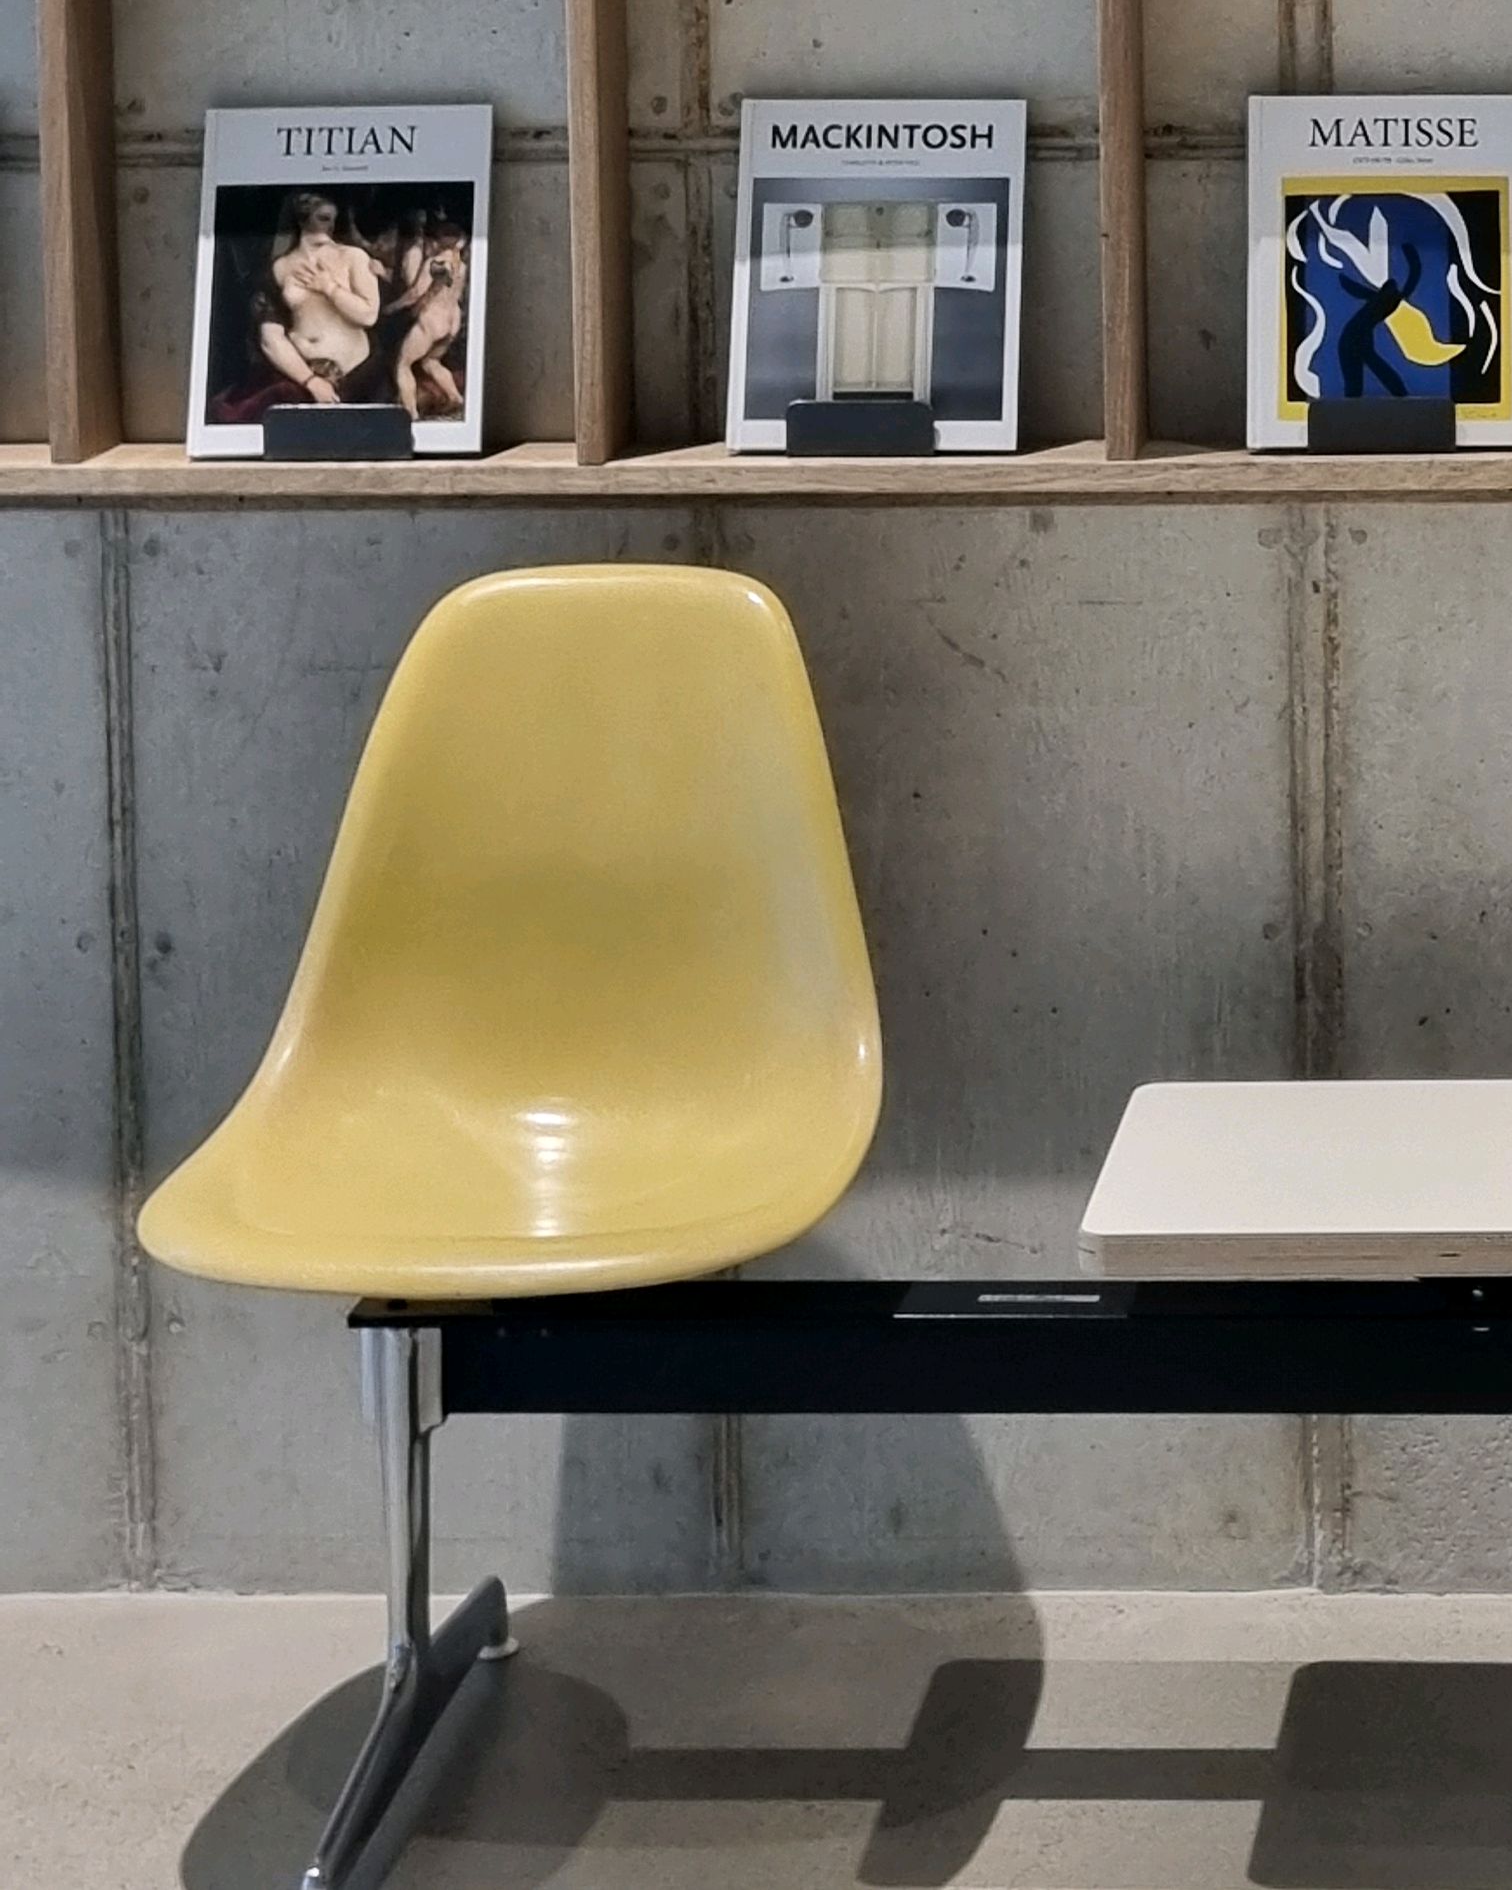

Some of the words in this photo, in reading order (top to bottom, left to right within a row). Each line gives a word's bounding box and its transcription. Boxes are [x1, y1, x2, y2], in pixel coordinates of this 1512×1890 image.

[275, 125, 418, 157] TITIAN
[771, 123, 995, 151] MACKINTOSH
[1307, 117, 1480, 148] MATISSE
